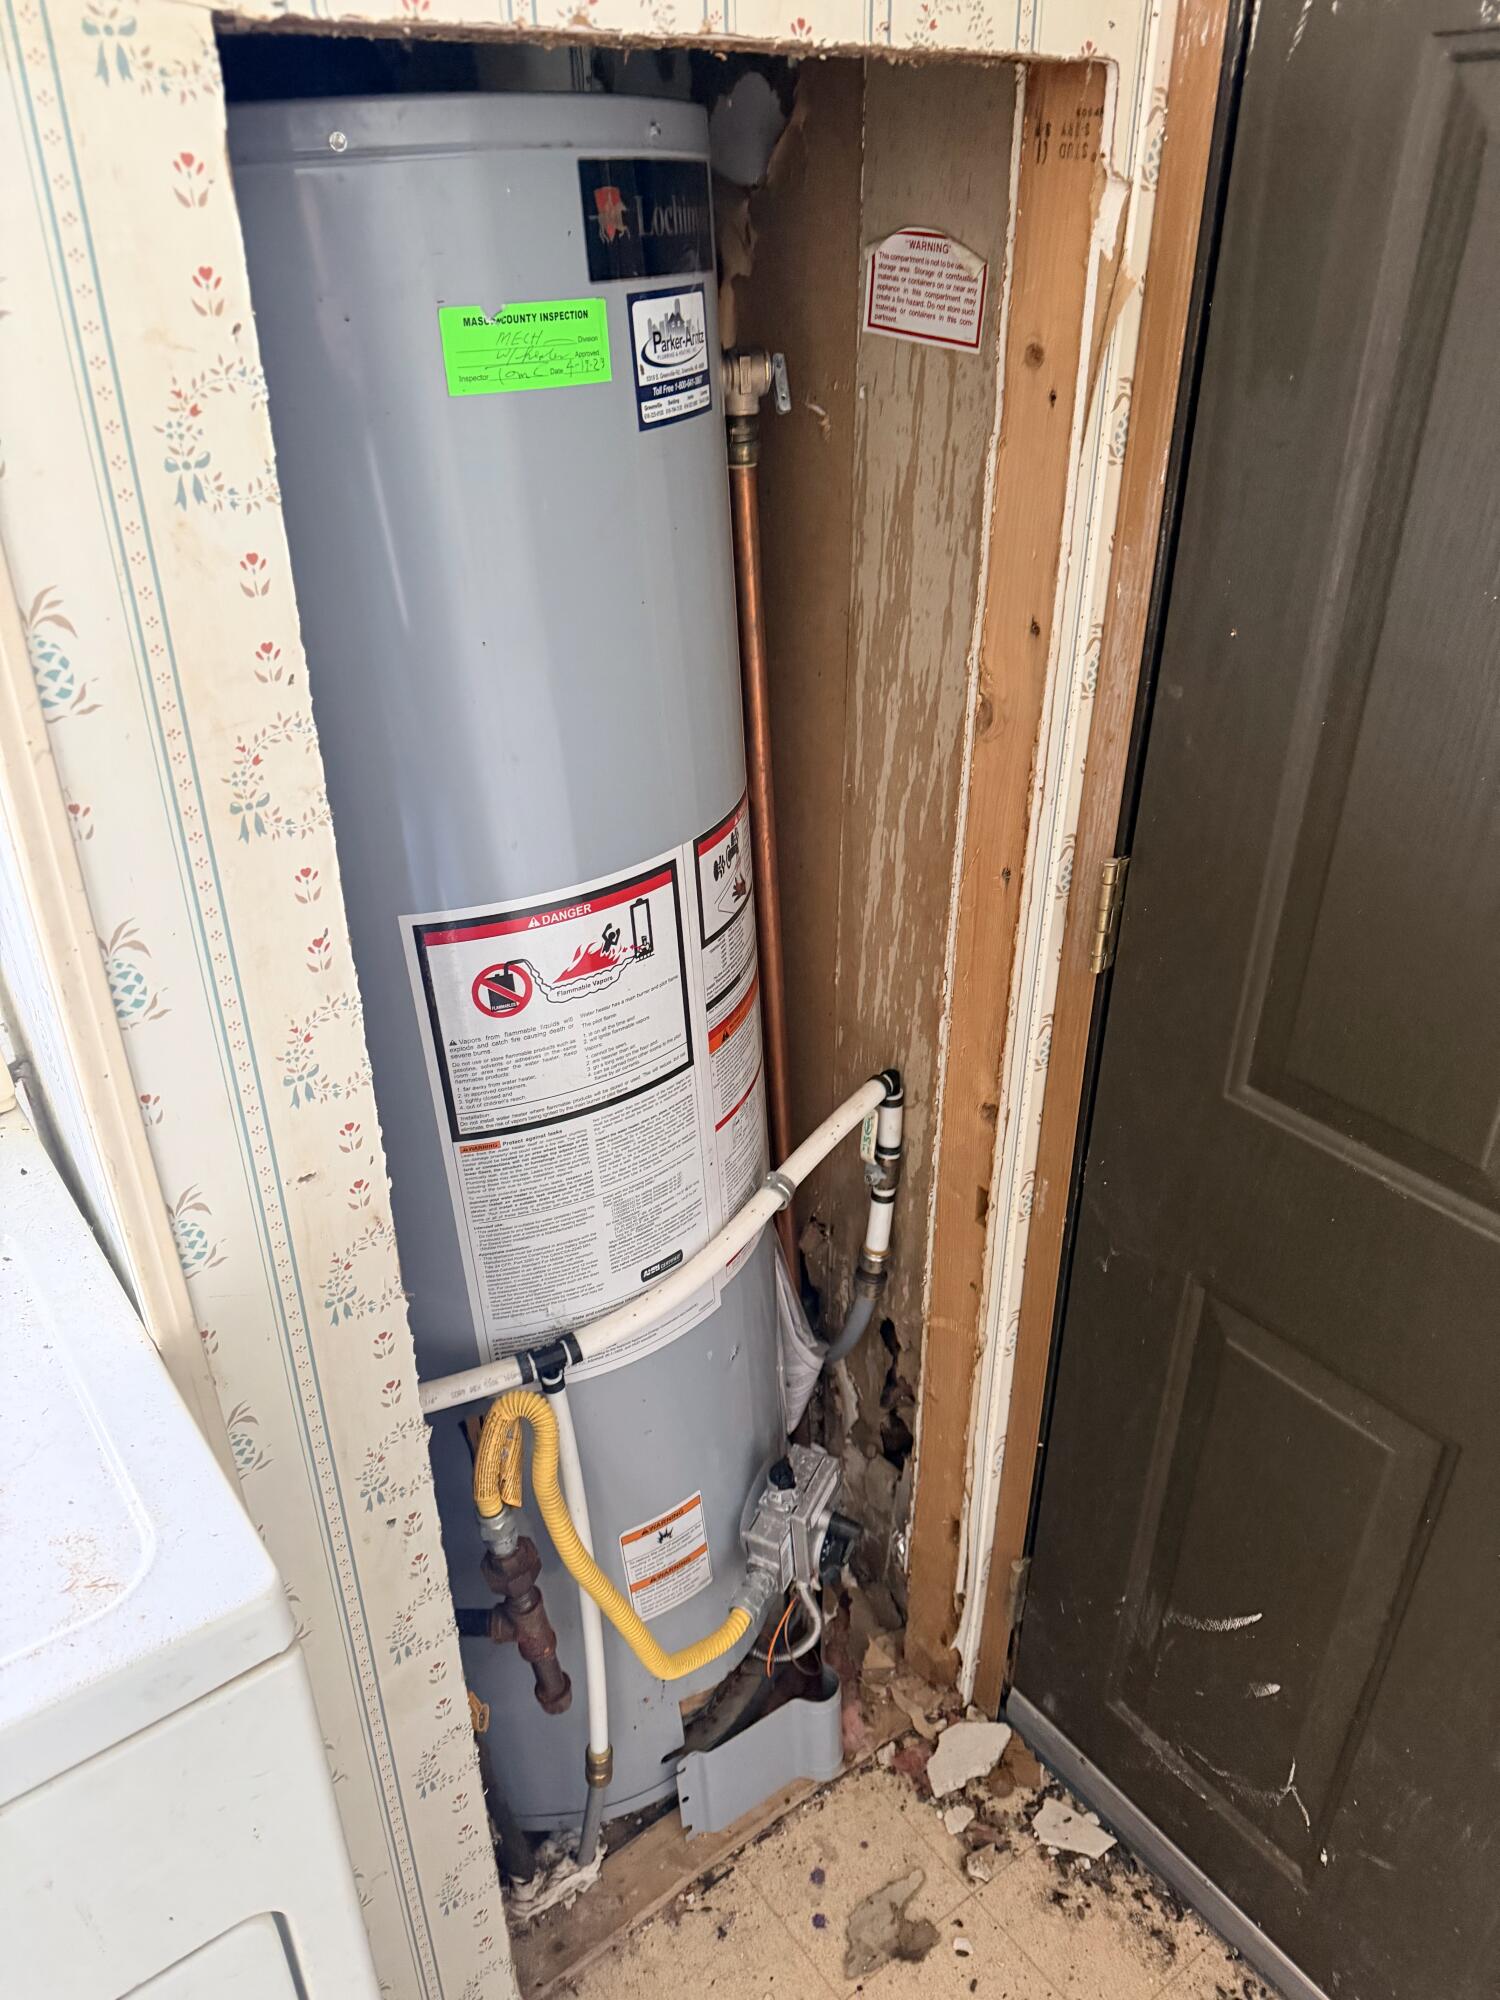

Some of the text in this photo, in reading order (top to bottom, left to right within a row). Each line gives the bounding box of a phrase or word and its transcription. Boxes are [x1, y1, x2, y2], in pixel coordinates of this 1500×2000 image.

[633, 194, 706, 237] Lochin
[880, 252, 889, 260] This
[890, 254, 924, 264] compartment
[878, 263, 896, 272] storage
[914, 267, 934, 278] Storage
[938, 270, 942, 278] of
[878, 273, 898, 282] materials
[908, 279, 935, 288] containers
[967, 286, 977, 296] any
[877, 283, 900, 294] appliance
[912, 287, 921, 296] this
[924, 290, 960, 302] compartment
[964, 298, 976, 306] may
[876, 294, 890, 302] create
[927, 302, 934, 310] Do
[948, 304, 960, 314] store
[962, 306, 975, 315] such
[463, 310, 588, 327] MAS COUNTY INSPECTION
[876, 303, 897, 313] materials
[909, 310, 936, 320] containers
[947, 314, 956, 324] this
[960, 318, 973, 326] com-
[496, 330, 544, 346] MECH
[575, 350, 600, 358] Approved
[458, 374, 488, 384] Inspector
[653, 386, 662, 396] Toll
[663, 384, 674, 394] Free
[542, 904, 592, 926] DANGER
[556, 975, 614, 998] Flammable Vapors
[450, 1044, 474, 1053] explode
[524, 1031, 546, 1040] causing
[549, 1026, 566, 1034] death
[459, 1037, 482, 1045] Vapors
[504, 1027, 536, 1037] flammable
[540, 1021, 560, 1030] liquids
[505, 1050, 532, 1058] flammable
[534, 1045, 556, 1055] products
[515, 1054, 542, 1062] adhesives
[471, 1088, 496, 1097] approved
[482, 1094, 500, 1102] closed
[483, 1098, 510, 1106] children's
[526, 1133, 546, 1142] against
[650, 1508, 684, 1531] WARNING
[658, 1558, 691, 1580] WARNING
